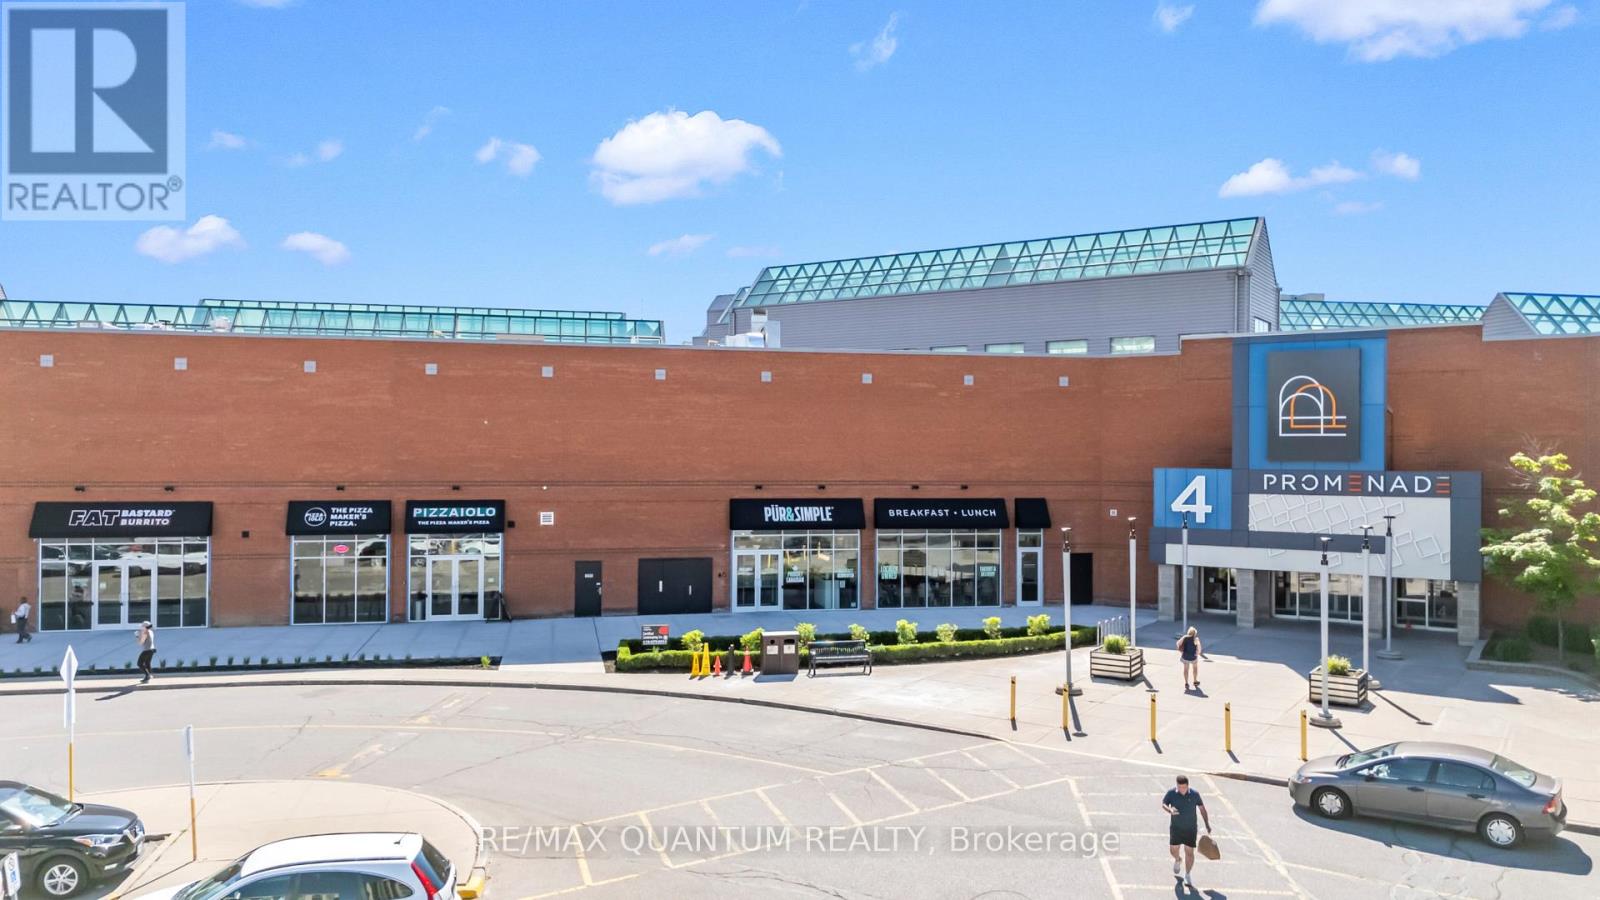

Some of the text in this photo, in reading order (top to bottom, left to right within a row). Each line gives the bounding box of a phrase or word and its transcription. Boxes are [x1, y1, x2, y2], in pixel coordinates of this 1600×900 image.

[1263, 474, 1450, 494] PROMENADE
[1170, 475, 1213, 523] 4
[68, 509, 121, 526] FAT
[121, 509, 174, 517] BASTARD
[413, 507, 497, 518] PIZZAIOLO
[888, 508, 997, 517] BREAKFAST LUNCH
[120, 518, 171, 526] BURRITO
